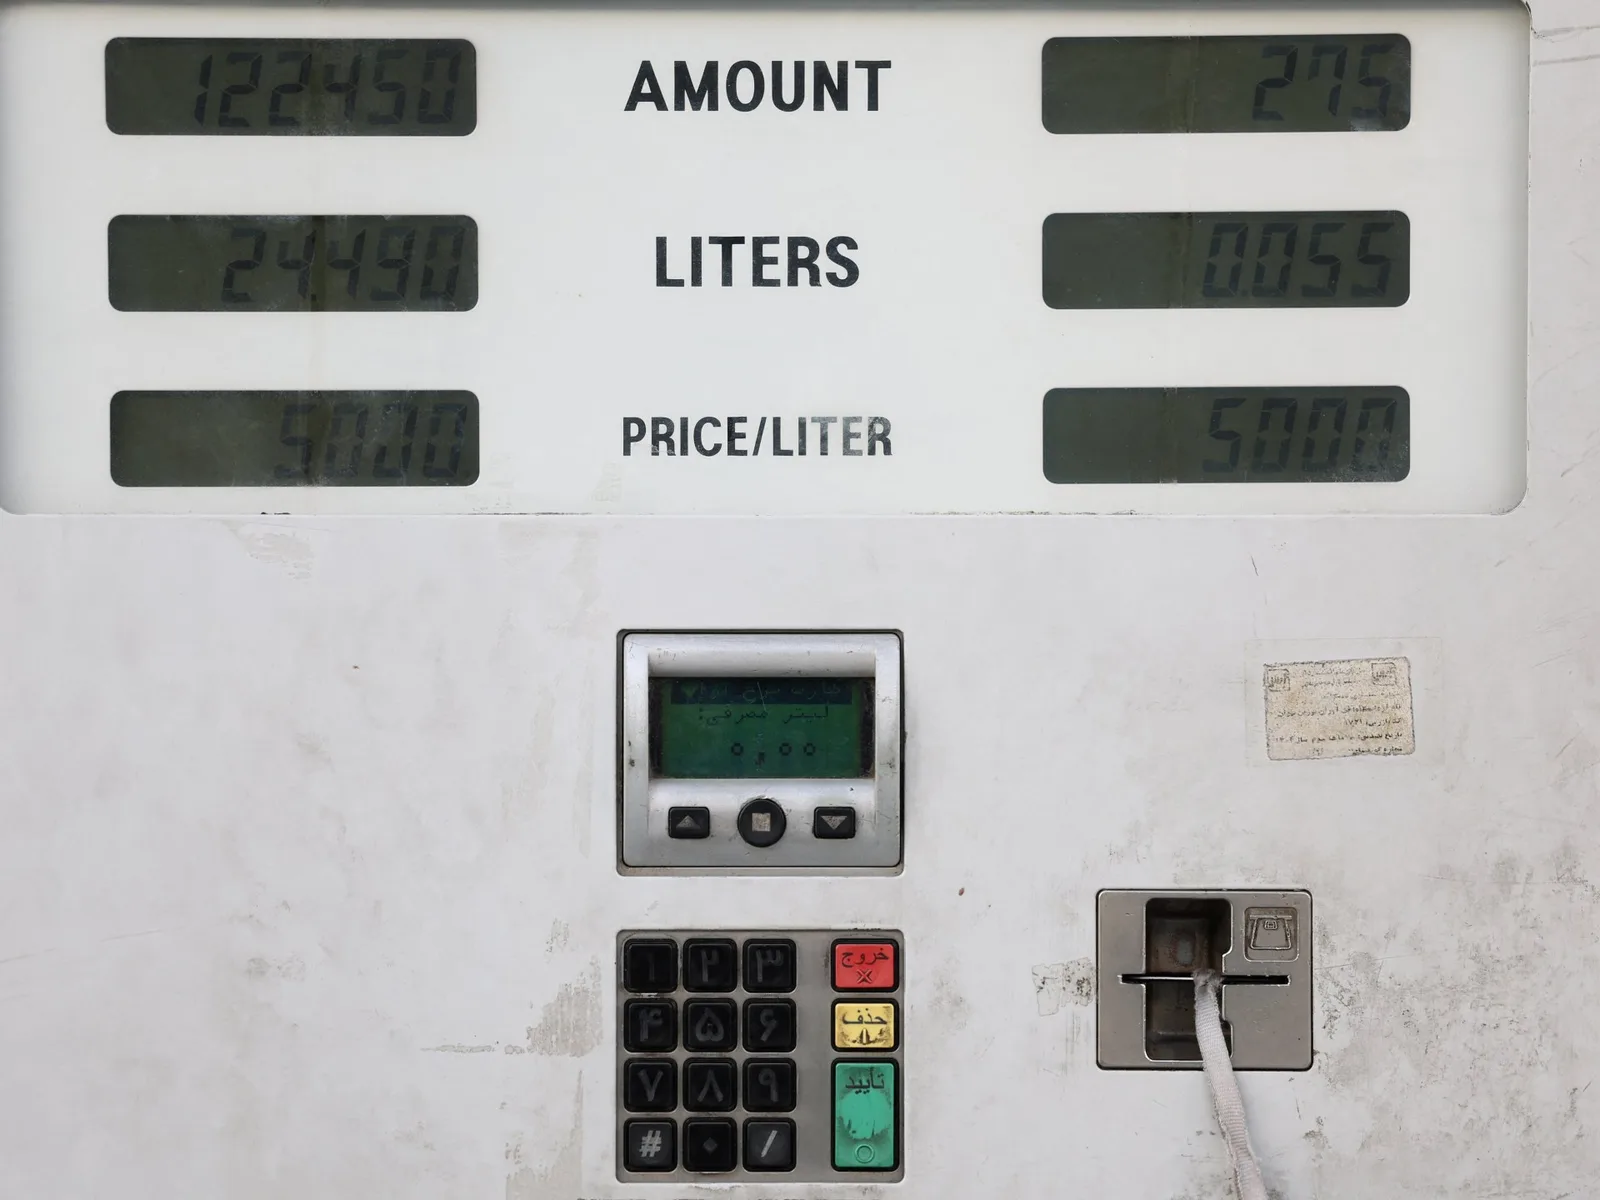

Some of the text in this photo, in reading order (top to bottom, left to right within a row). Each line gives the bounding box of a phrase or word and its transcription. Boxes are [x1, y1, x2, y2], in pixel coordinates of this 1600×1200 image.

[194, 49, 462, 128] 122450
[623, 60, 892, 112] AMOUNT
[1251, 43, 1395, 122] 275
[655, 236, 860, 288] LITERS
[1202, 222, 1396, 299] 0.055
[274, 402, 468, 480] 5000
[622, 416, 893, 456] PRICE/LITER
[1202, 397, 1397, 474] 5000
[699, 948, 719, 983] ۲
[755, 948, 785, 983] ۳
[841, 946, 890, 968] خروج
[695, 1007, 725, 1043] ۵
[759, 1008, 779, 1043] ۶
[841, 1008, 888, 1026] حذف
[637, 1068, 664, 1103] ۷
[696, 1068, 724, 1103] ۸
[757, 1067, 779, 1103] ۹
